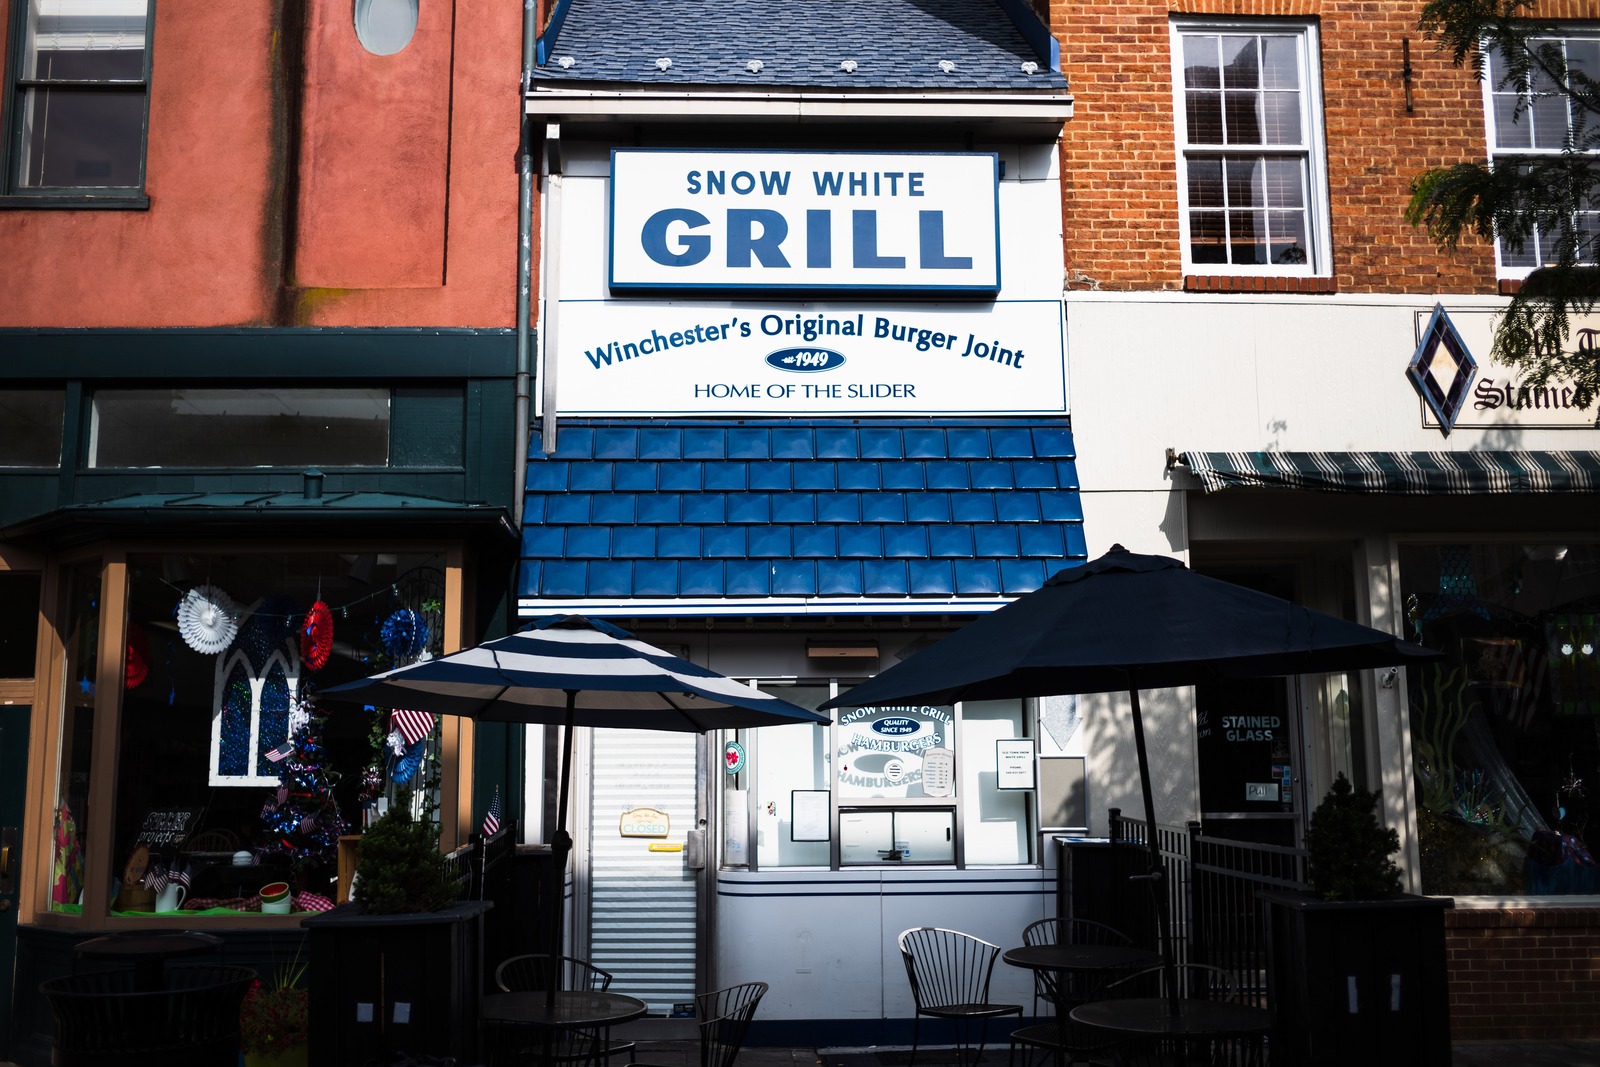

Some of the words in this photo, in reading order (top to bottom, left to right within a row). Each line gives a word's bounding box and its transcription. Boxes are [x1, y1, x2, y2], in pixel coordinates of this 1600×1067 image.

[687, 170, 791, 196] SNOW
[813, 171, 925, 197] WHITE
[640, 207, 973, 270] GRILL
[583, 317, 752, 370] Winchester's
[760, 312, 863, 342] Original
[874, 317, 958, 352] Burger
[961, 333, 1025, 369] Joint
[795, 351, 829, 367] 1949
[694, 383, 761, 399] HOME
[767, 383, 798, 399] OF
[800, 384, 842, 399] THE
[847, 383, 917, 399] SLIDER
[841, 706, 877, 726] SNOW
[920, 705, 952, 726] GRILL
[1222, 716, 1281, 728] STAINED
[851, 732, 942, 753] HAMBURGERS
[1226, 730, 1274, 741] GLASS
[1248, 784, 1268, 797] Pull
[623, 824, 667, 834] CLOSED
